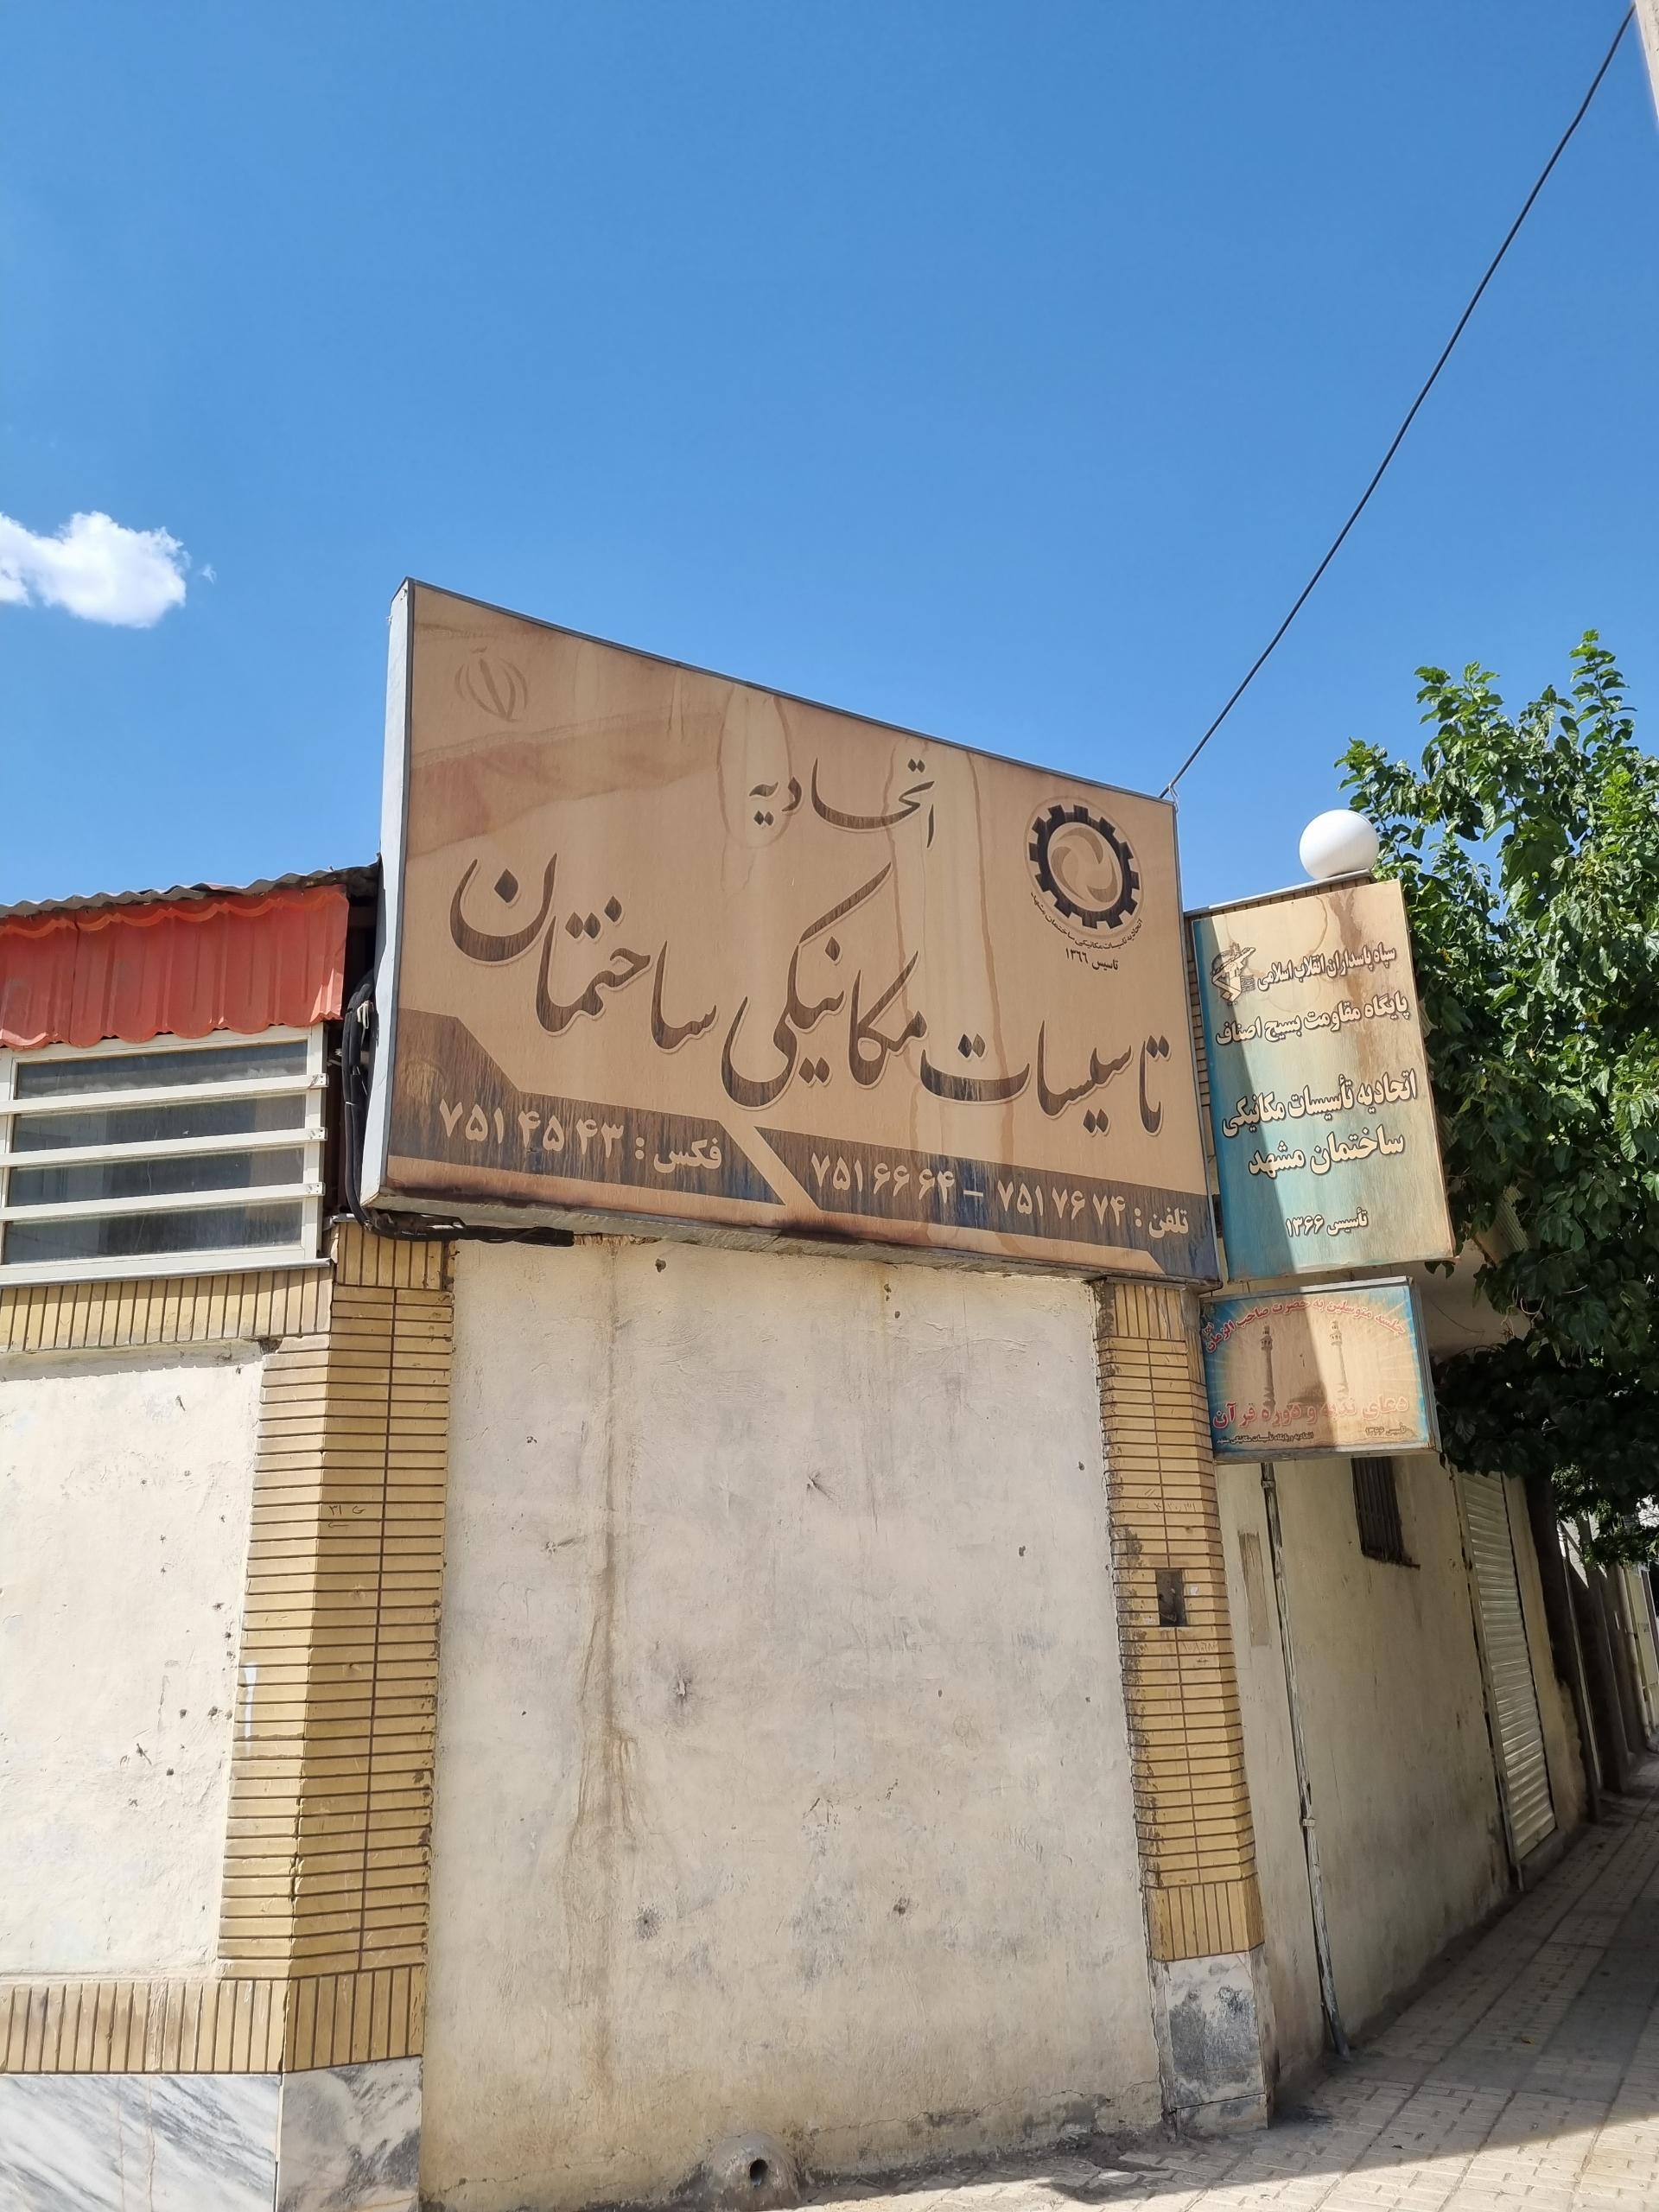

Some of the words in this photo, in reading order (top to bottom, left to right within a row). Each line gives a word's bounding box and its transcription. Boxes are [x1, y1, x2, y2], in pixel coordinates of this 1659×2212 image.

[748, 758, 935, 850] اتحادیه
[450, 852, 718, 1053] ساختمان
[1294, 953, 1326, 982] انقلاب
[1326, 944, 1374, 978] پاسداران
[1373, 942, 1396, 969] سپاه
[721, 861, 928, 1109] مکانیکی
[1256, 961, 1294, 991] اسلامی
[1303, 1001, 1362, 1033] مقاومت
[1363, 991, 1411, 1021] پایگاه
[1215, 1016, 1262, 1046] اصناف
[1264, 1014, 1303, 1042] بسیج
[1357, 1068, 1417, 1114] اتحادیه
[1222, 1091, 1287, 1138] مکانیکی
[1248, 1140, 1306, 1179] مشهد
[1309, 1123, 1406, 1175] ساختمان
[1285, 1213, 1325, 1237] ۱۳۶۶
[1236, 1306, 1270, 1328] صاحب
[1271, 1298, 1311, 1314] حضرت
[1313, 1299, 1325, 1311] به
[1326, 1300, 1373, 1319] متوسلین
[1306, 1404, 1318, 1424] و
